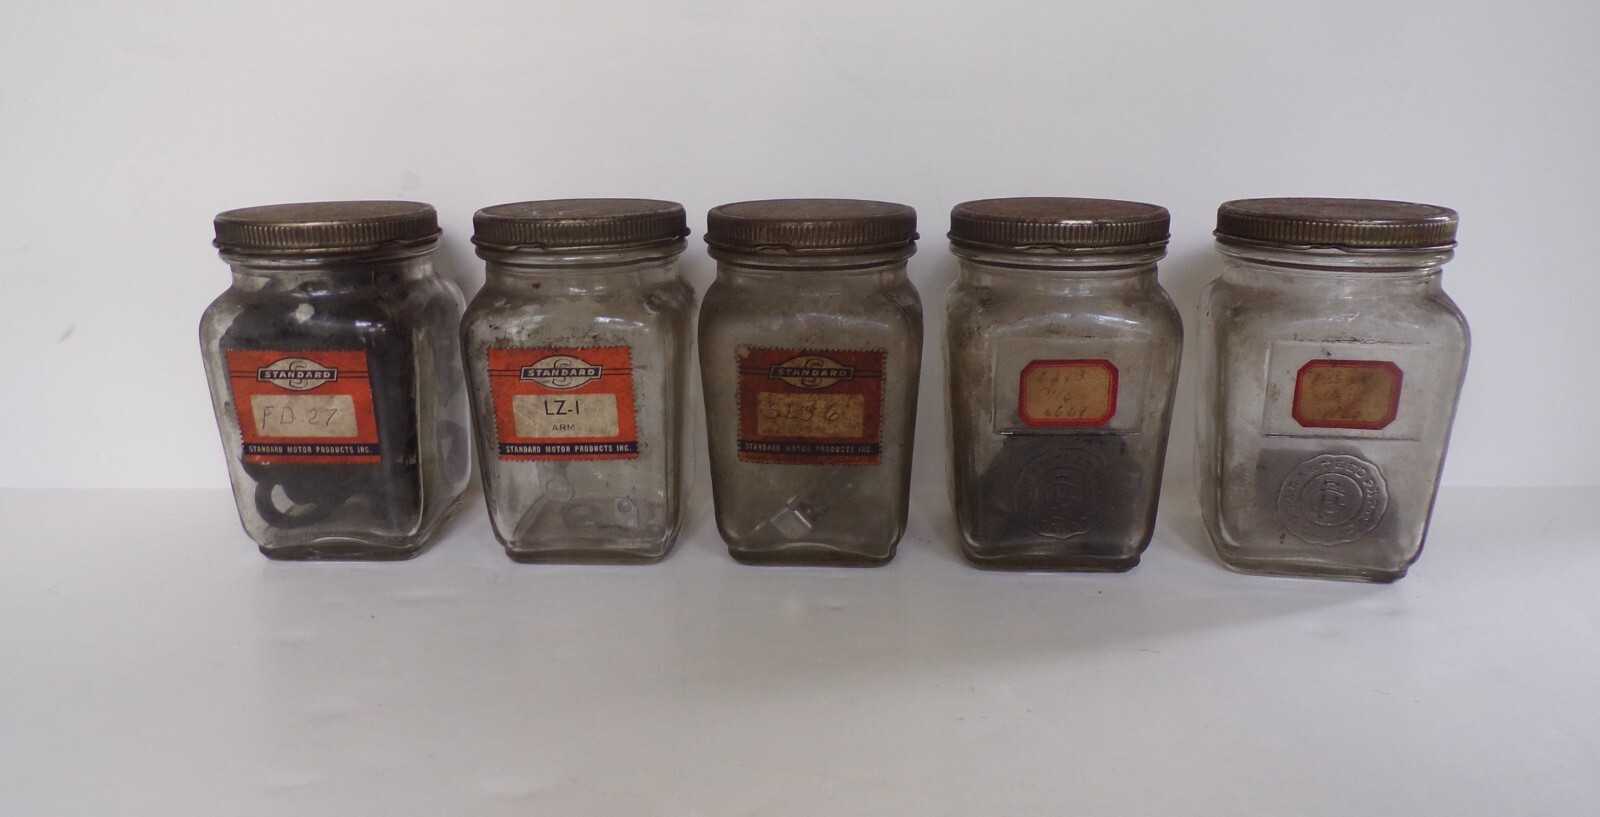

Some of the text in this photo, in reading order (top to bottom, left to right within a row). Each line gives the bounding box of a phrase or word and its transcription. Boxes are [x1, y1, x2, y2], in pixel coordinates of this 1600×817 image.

[528, 369, 595, 377] STANDARD
[777, 369, 847, 377] STANDARD
[308, 408, 337, 427] 27
[249, 445, 283, 453] STANDARD
[745, 443, 780, 451] STANDARD
[815, 445, 854, 453] PRODUCTS
